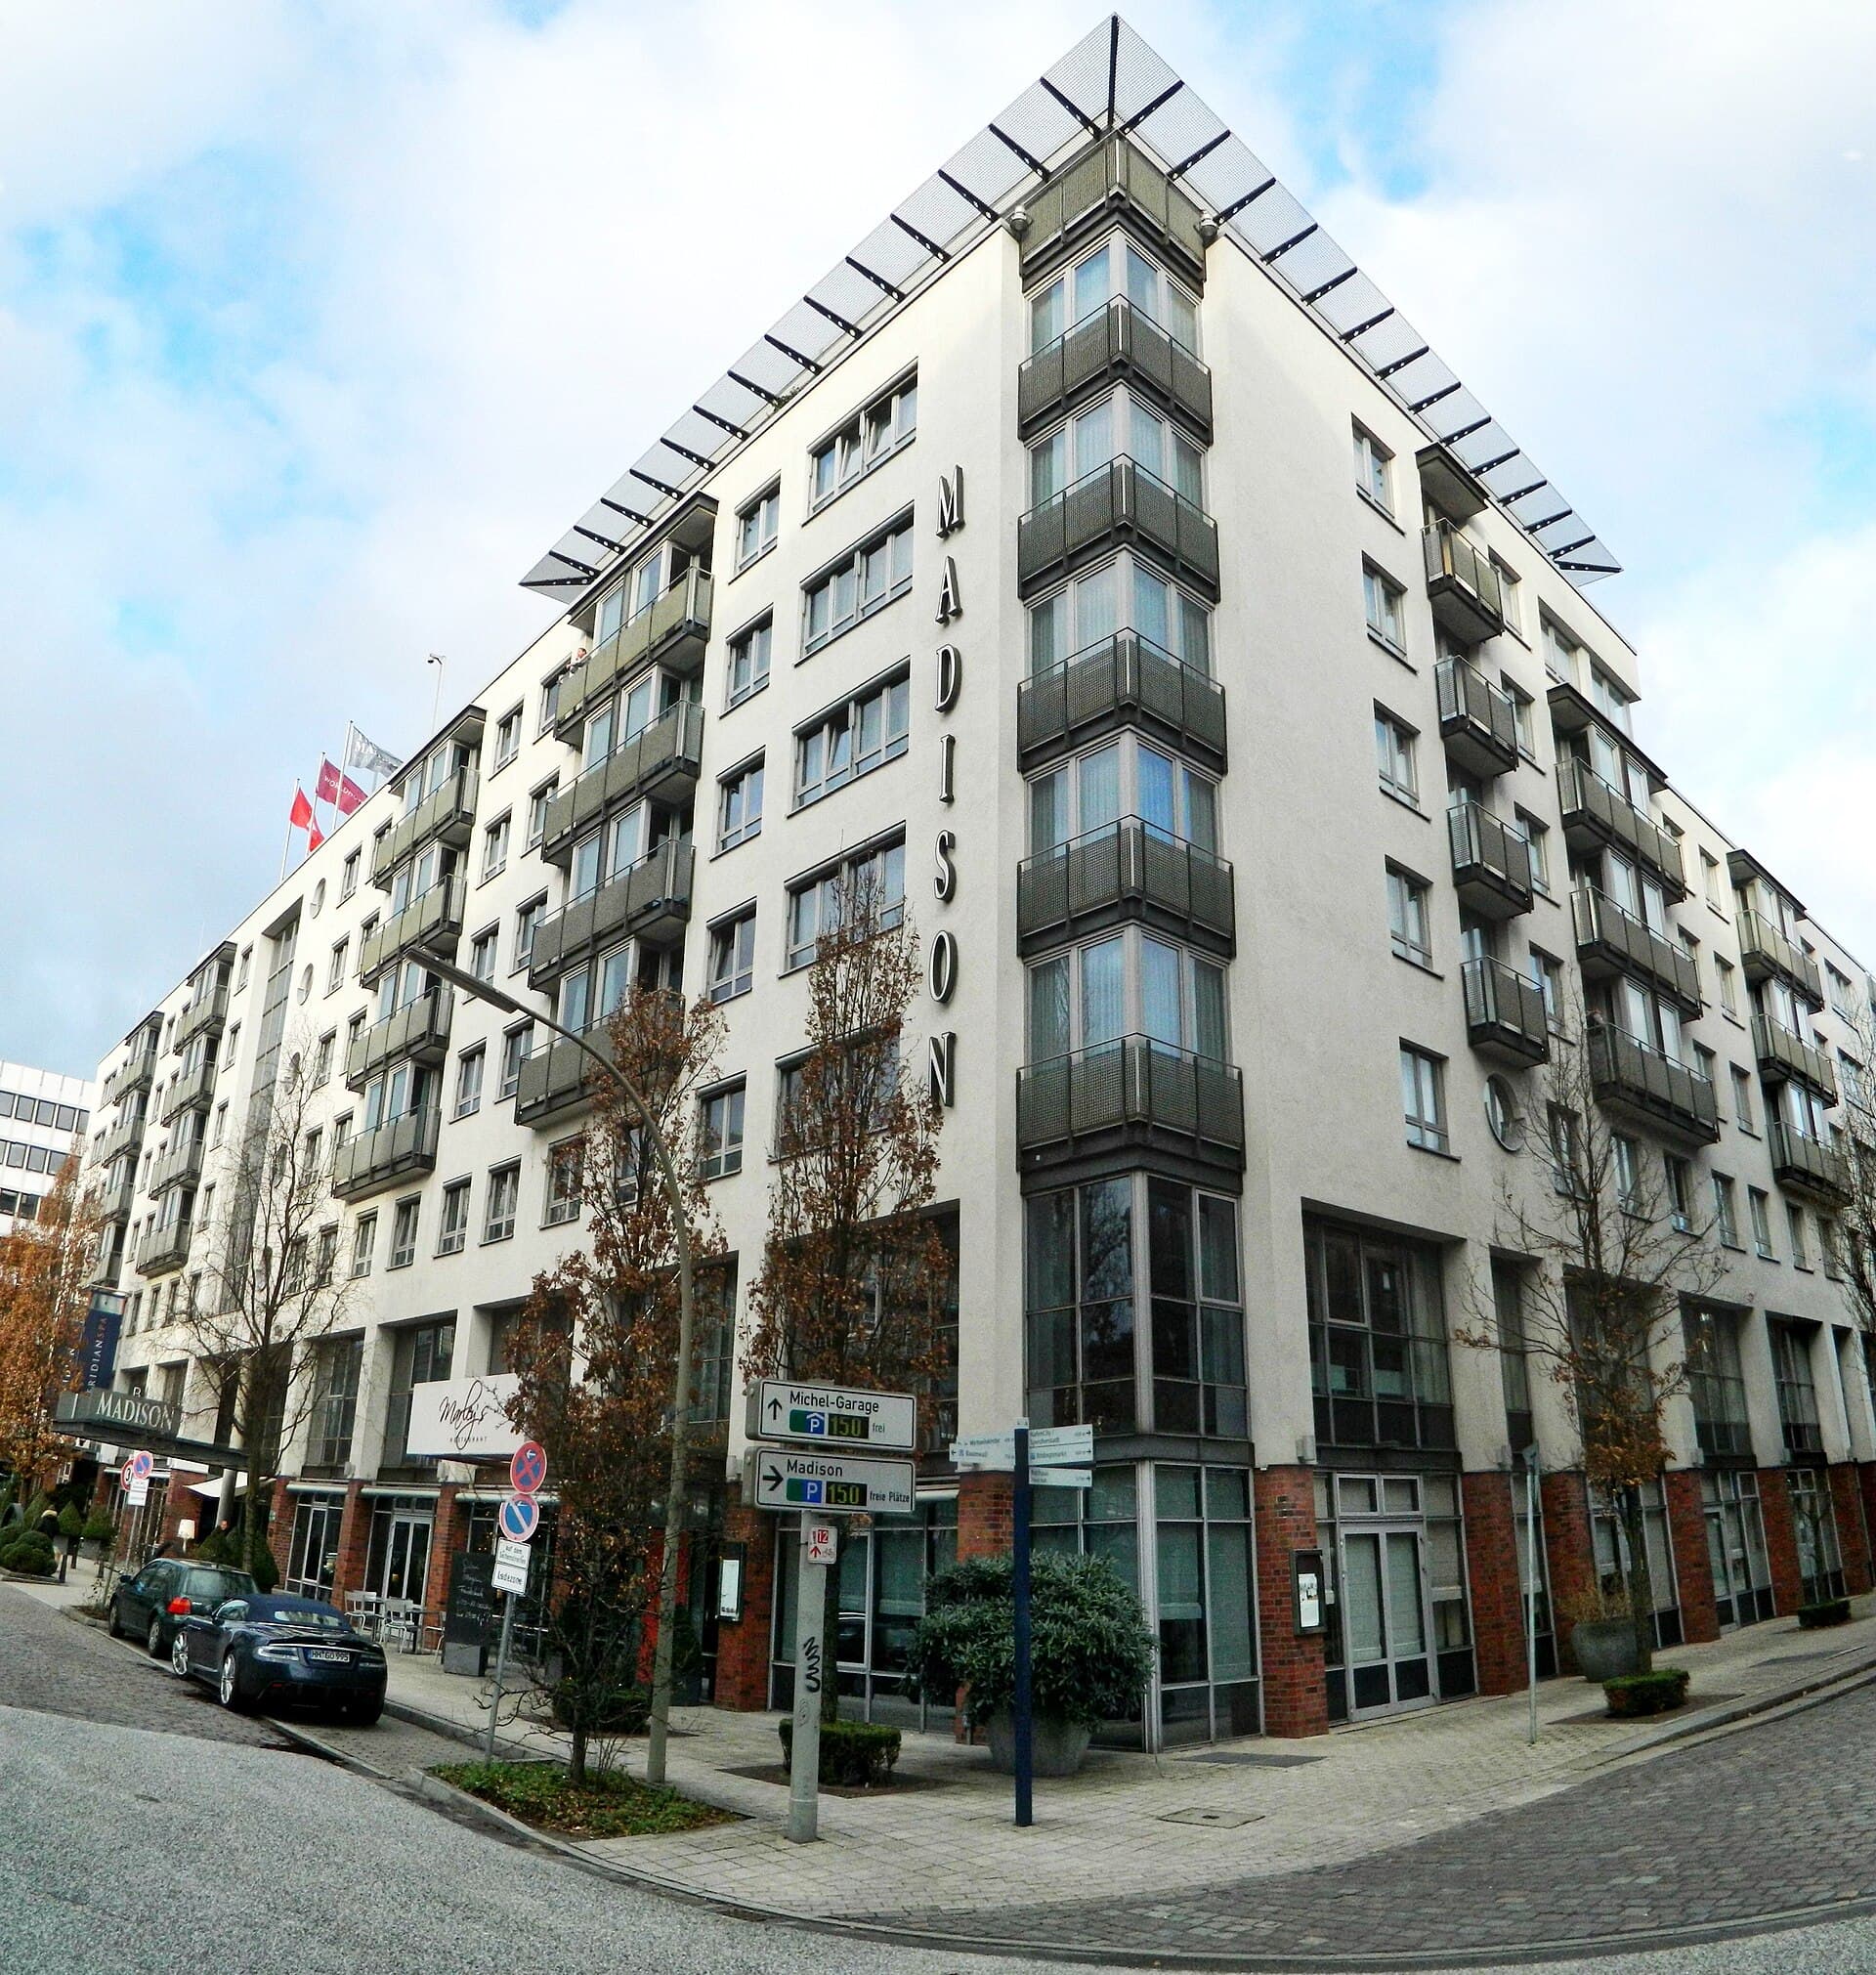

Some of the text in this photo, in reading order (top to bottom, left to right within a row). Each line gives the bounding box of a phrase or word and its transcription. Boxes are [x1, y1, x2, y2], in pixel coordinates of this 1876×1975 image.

[928, 464, 965, 1108] MADISON
[97, 1392, 175, 1431] MADISON
[789, 1391, 879, 1415] Michel-Garage
[831, 1417, 861, 1437] 150
[873, 1422, 885, 1434] frei
[787, 1458, 843, 1477] Madison
[829, 1483, 860, 1505] 150
[870, 1491, 886, 1502] freie
[889, 1491, 910, 1503] Plätze
